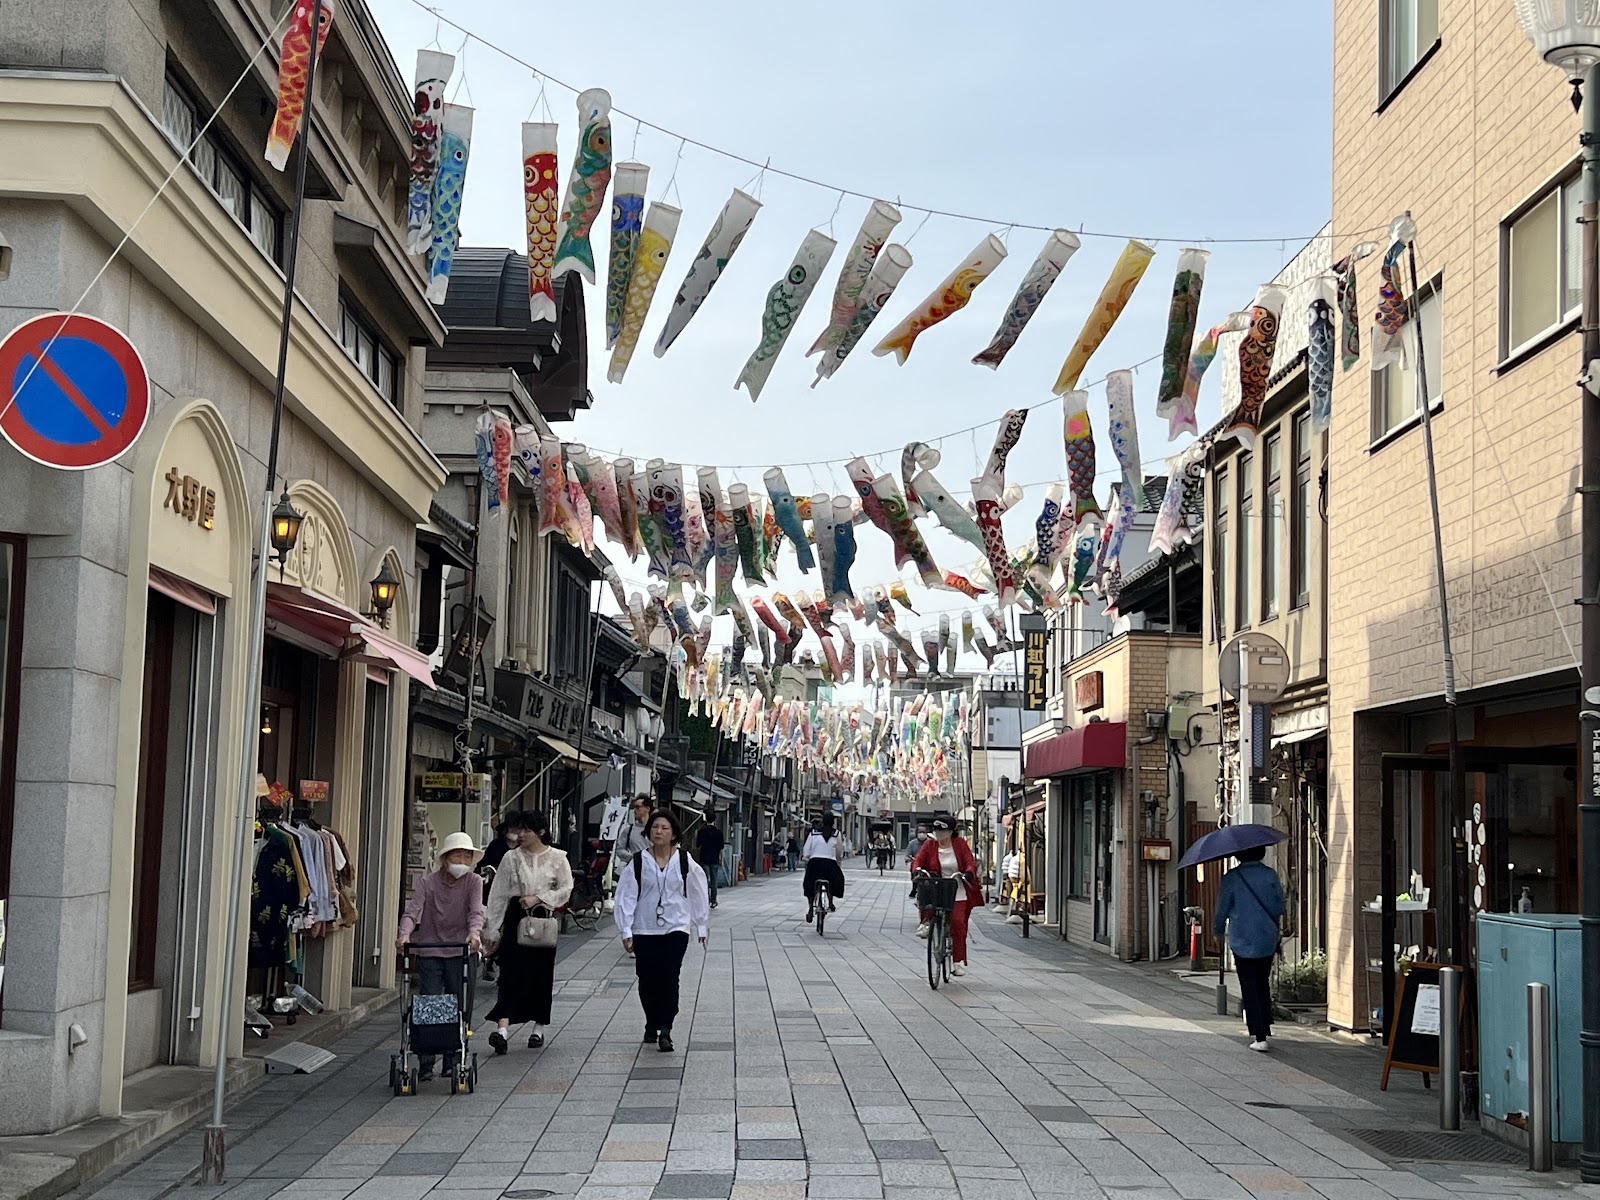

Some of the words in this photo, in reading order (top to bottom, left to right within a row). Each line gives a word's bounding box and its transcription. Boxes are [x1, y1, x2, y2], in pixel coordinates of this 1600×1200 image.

[163, 466, 216, 531] 大野屋
[1027, 632, 1044, 709] 川越タルト
